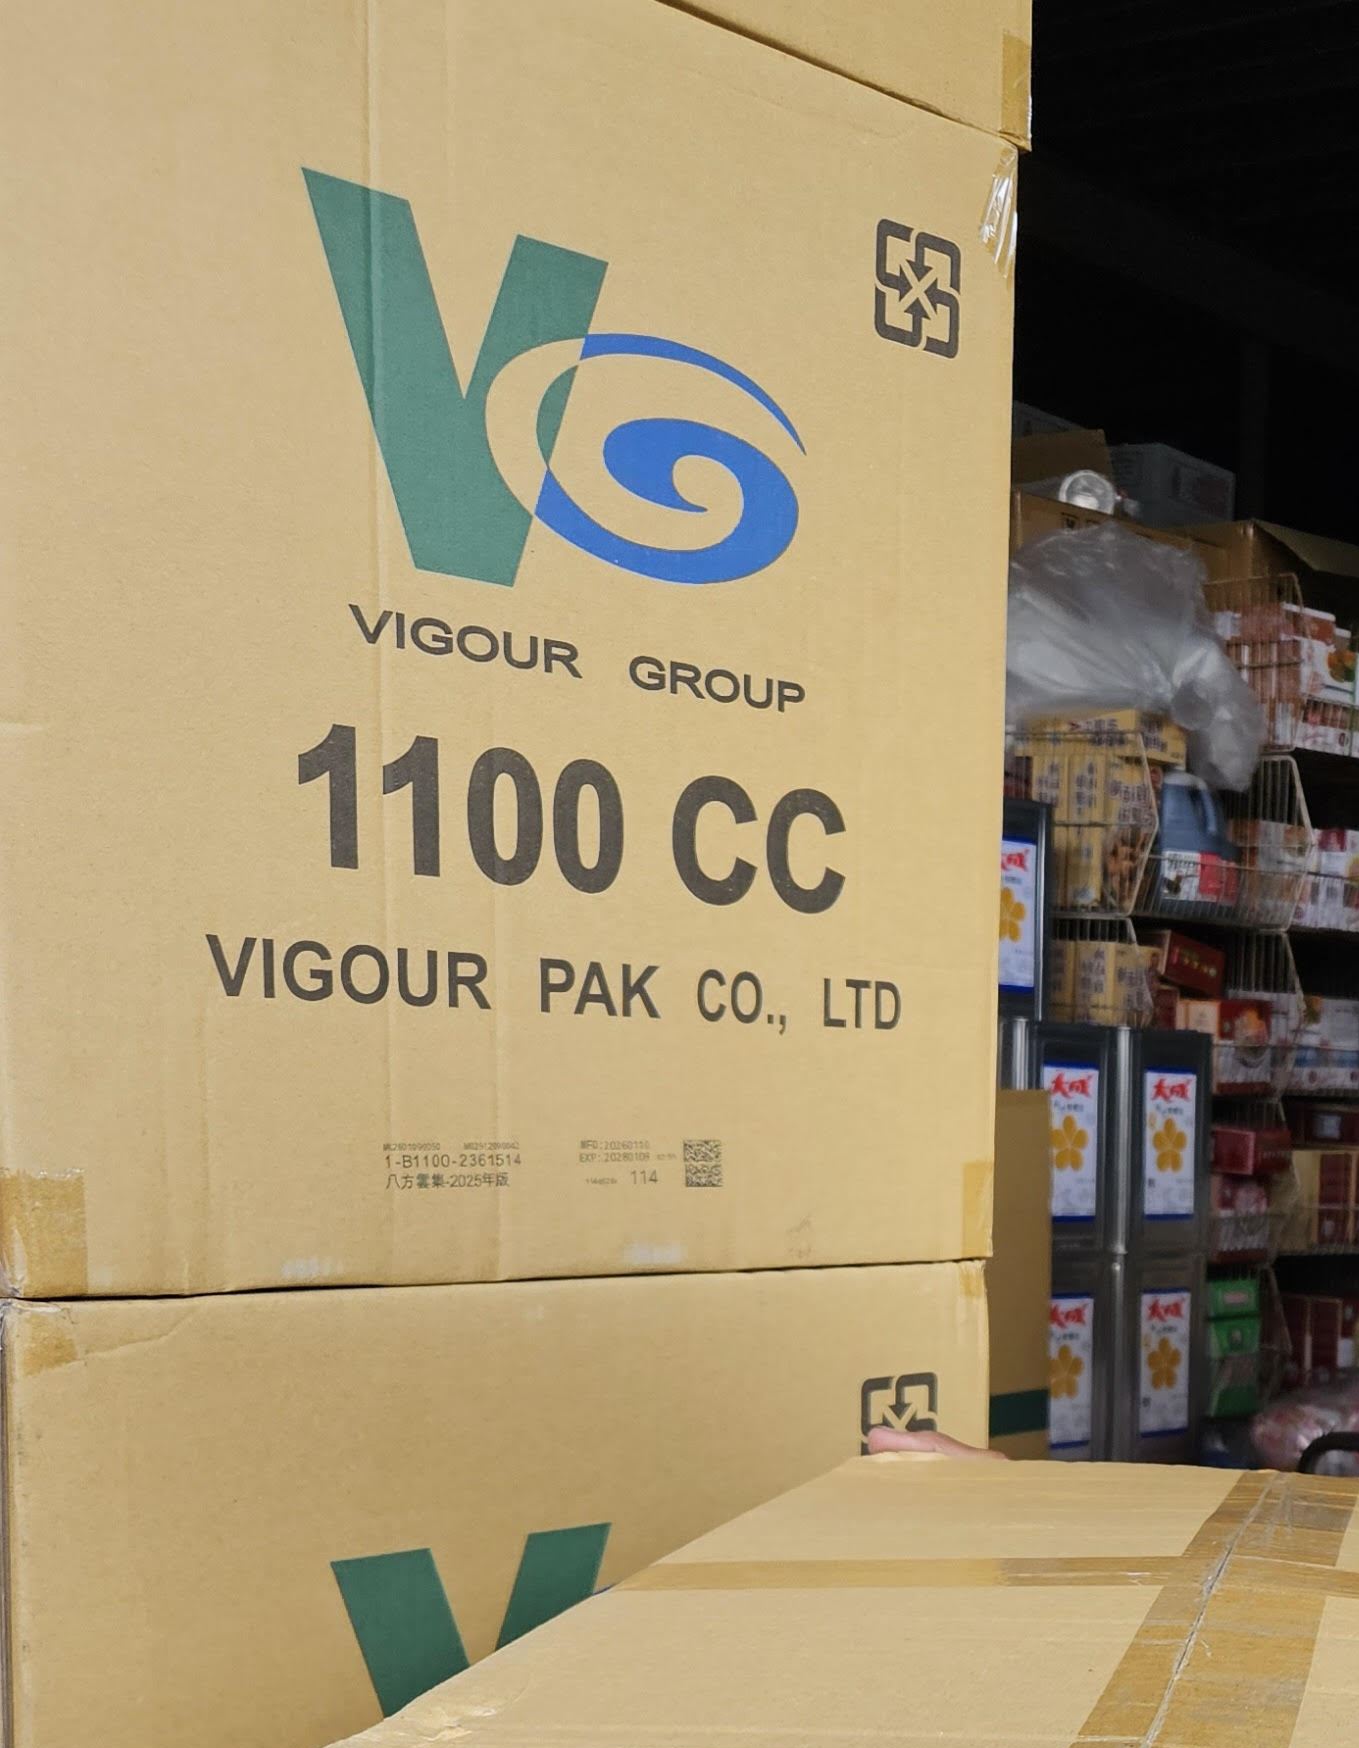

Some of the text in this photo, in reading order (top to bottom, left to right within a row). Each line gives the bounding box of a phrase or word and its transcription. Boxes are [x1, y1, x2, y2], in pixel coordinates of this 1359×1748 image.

[348, 604, 806, 713] VIGOUR GROUP
[297, 723, 847, 914] 1100 CC
[206, 934, 901, 1034] VIGOUR PAK CO., LTD
[630, 1169, 658, 1185] 114
